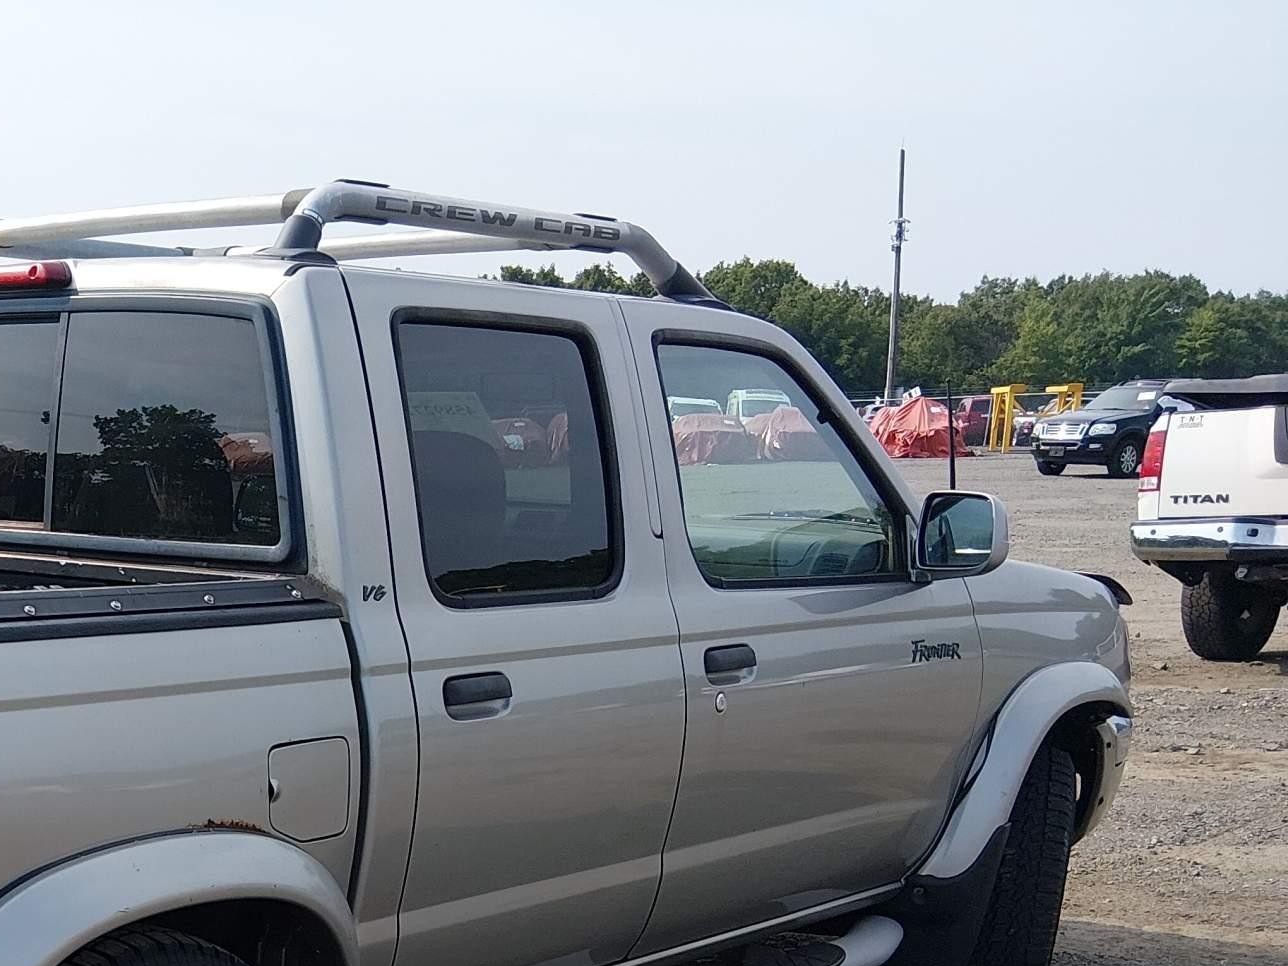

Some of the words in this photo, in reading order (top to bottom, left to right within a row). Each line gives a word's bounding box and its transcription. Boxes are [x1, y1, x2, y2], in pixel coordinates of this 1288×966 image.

[376, 196, 517, 227] CREW
[534, 217, 620, 241] CAB
[1170, 494, 1230, 504] TITAN
[363, 584, 387, 602] V6
